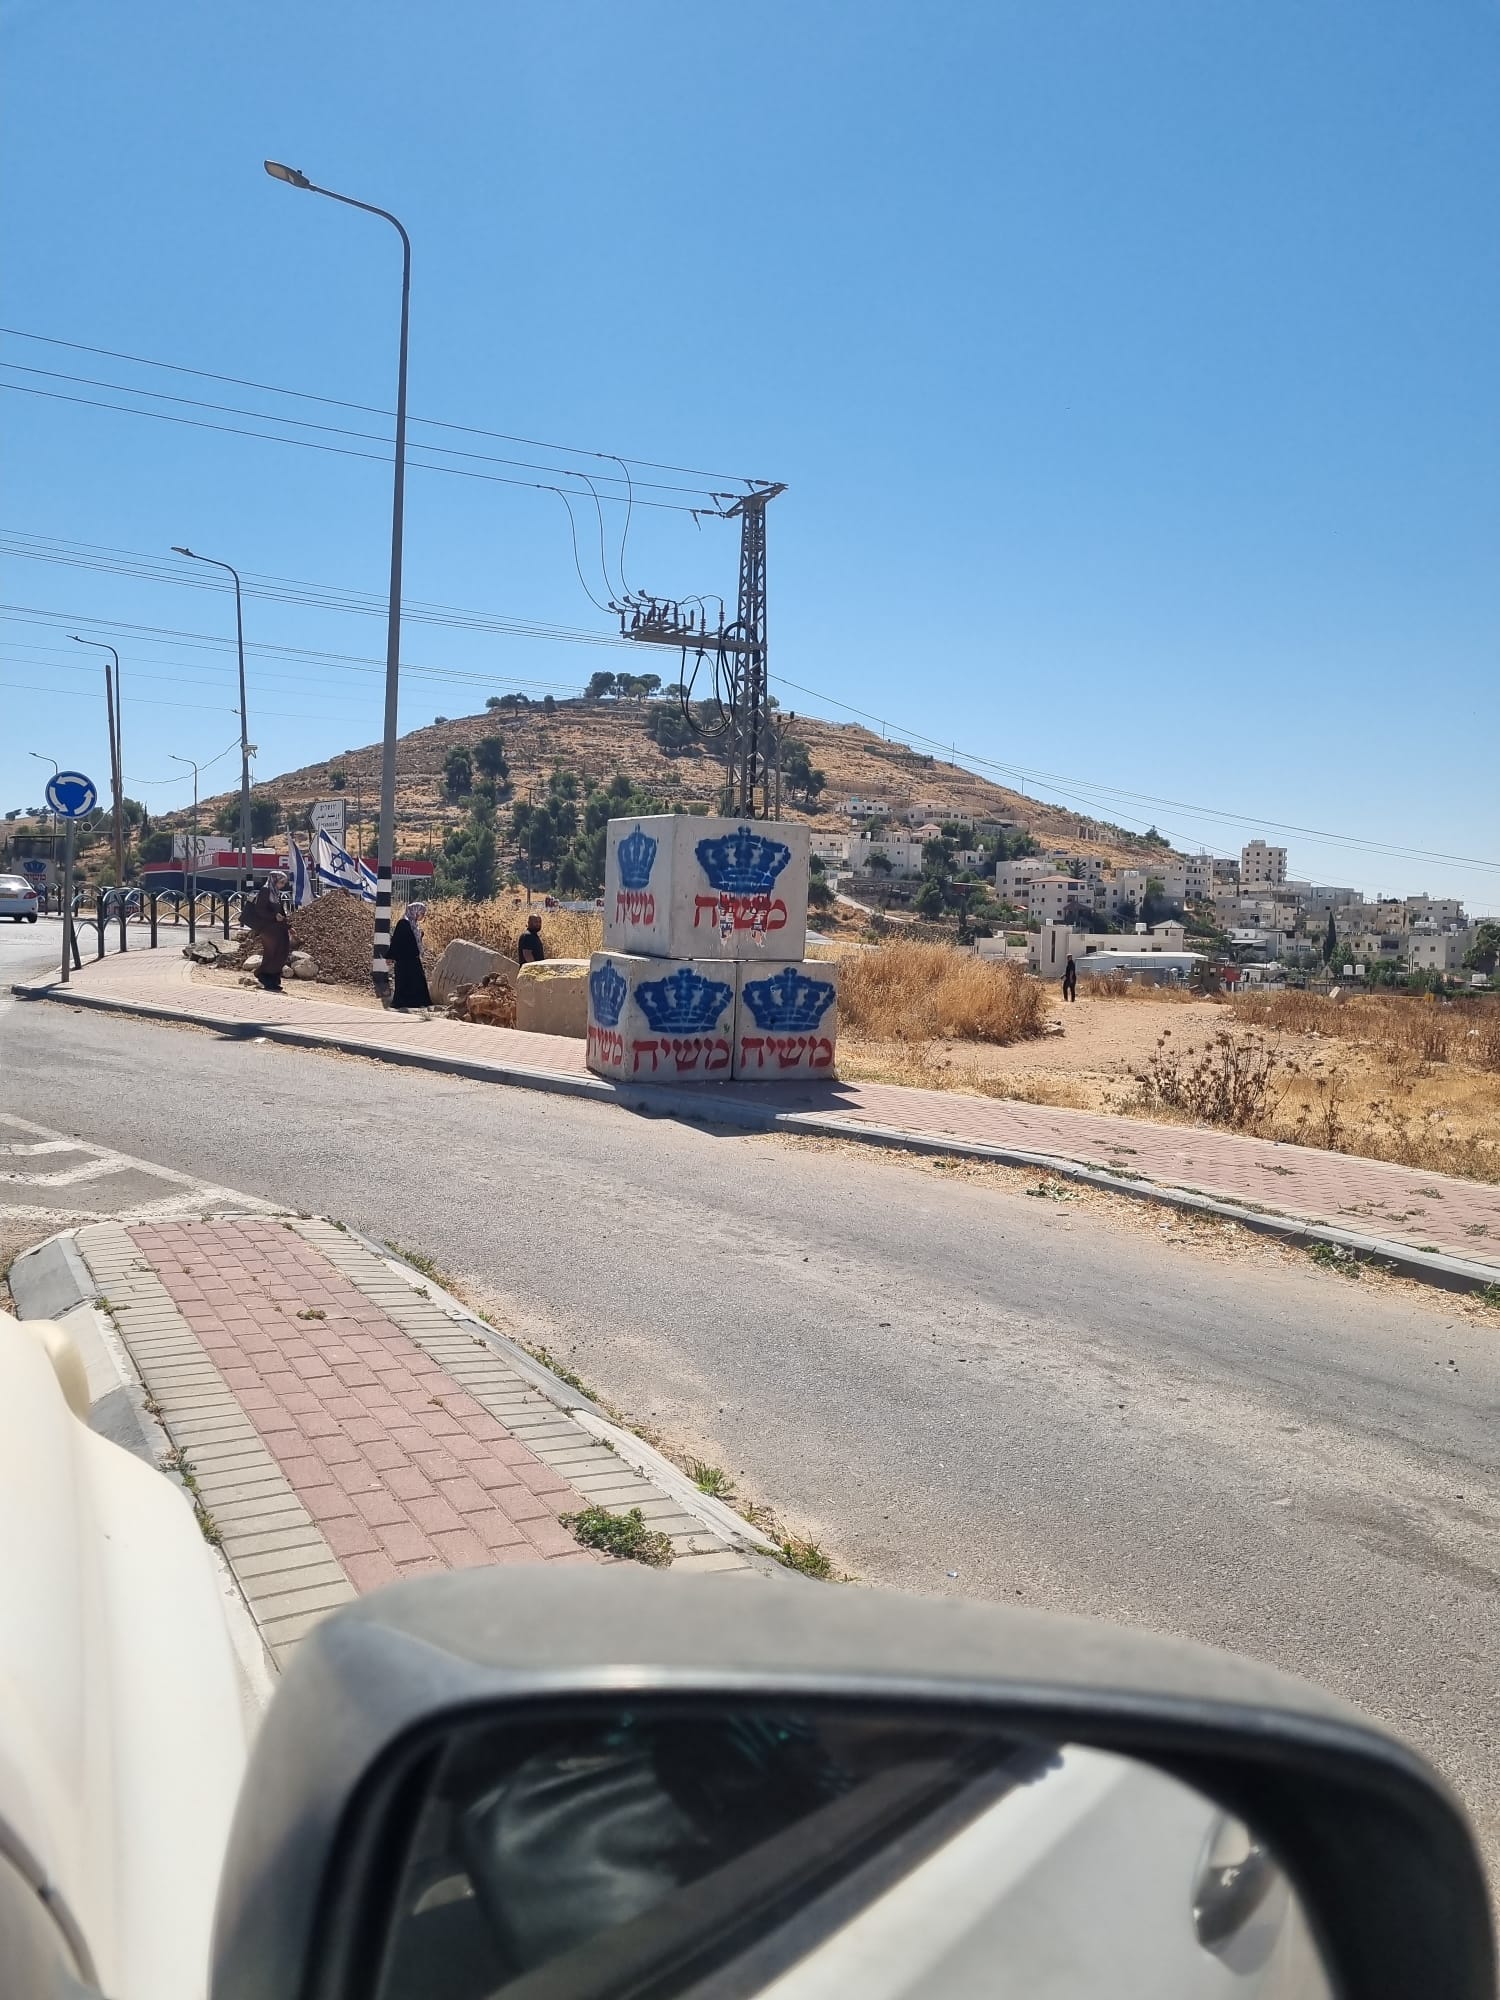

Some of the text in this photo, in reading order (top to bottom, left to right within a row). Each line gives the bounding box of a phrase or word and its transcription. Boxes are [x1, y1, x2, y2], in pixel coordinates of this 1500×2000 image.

[616, 891, 655, 925] משיח
[587, 1025, 623, 1066] משיח
[632, 1037, 730, 1072] משיח
[740, 1035, 832, 1068] משיח
